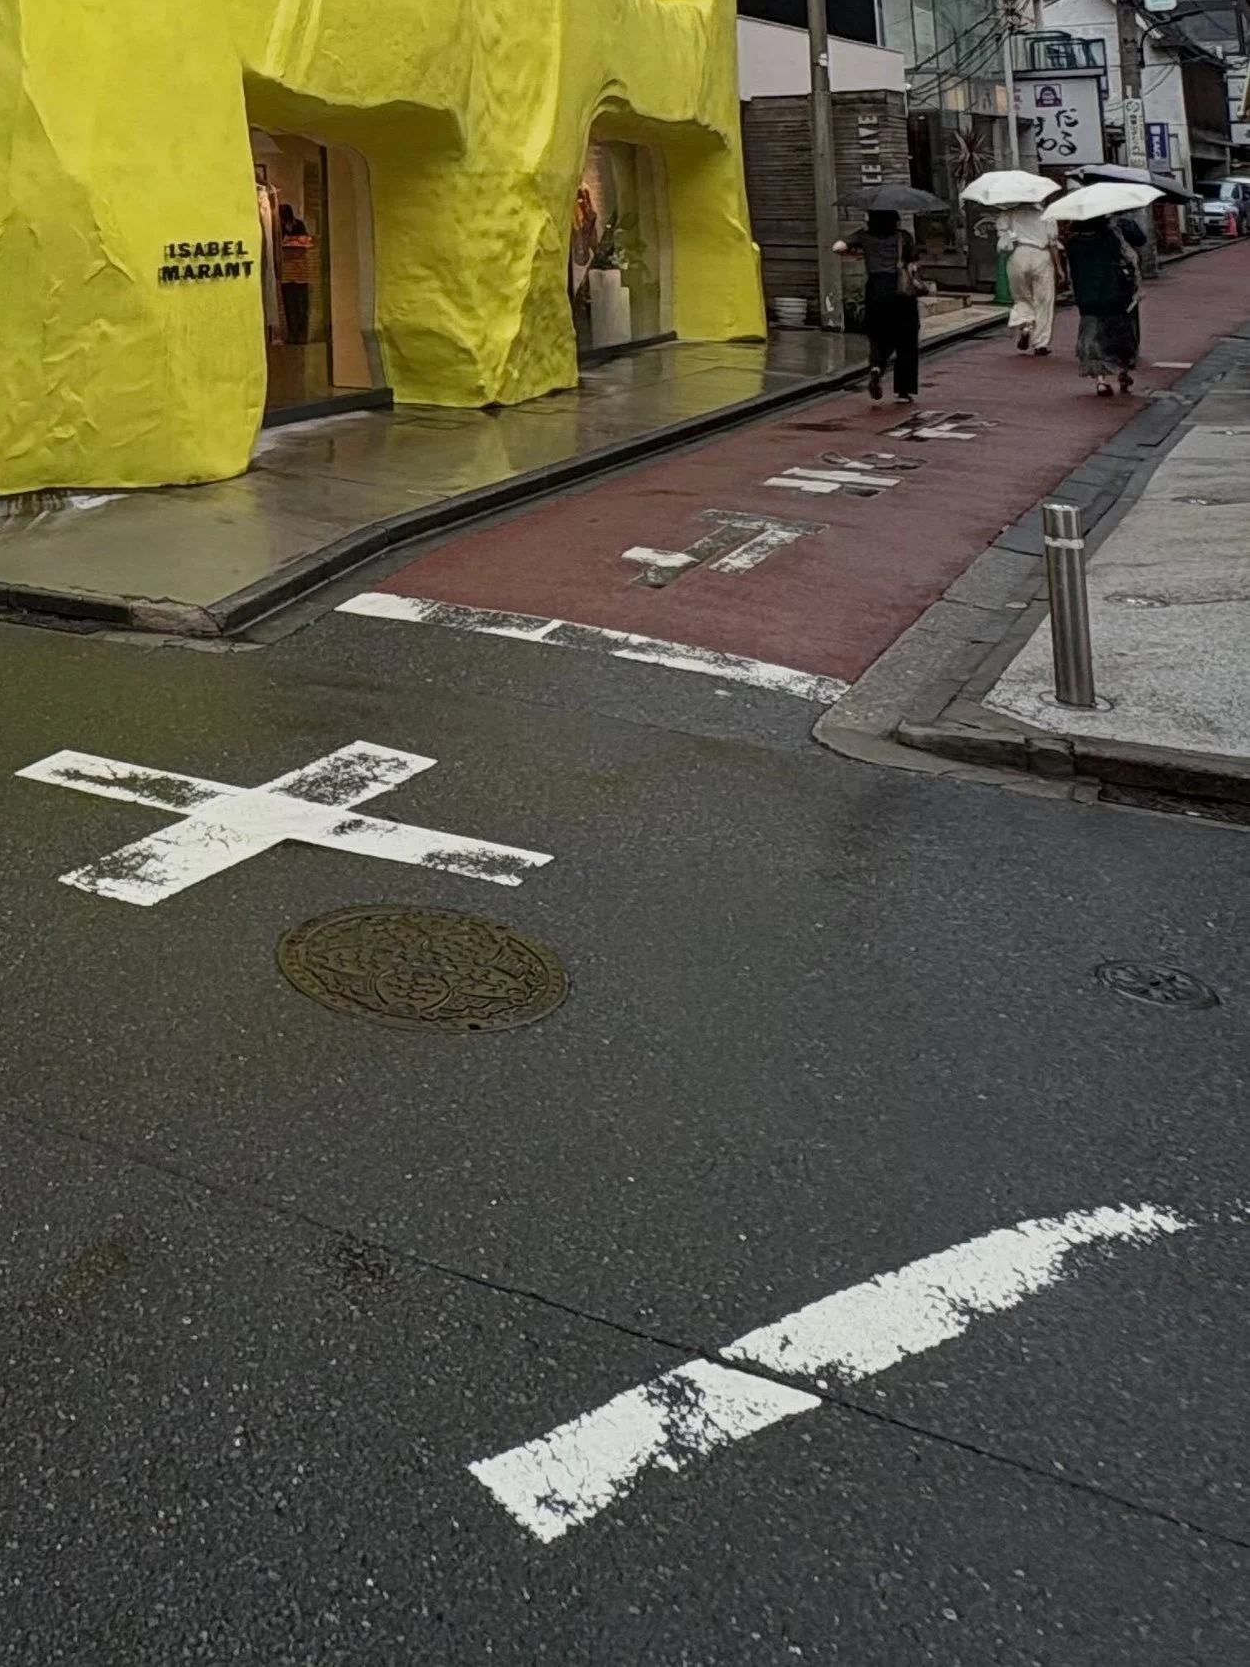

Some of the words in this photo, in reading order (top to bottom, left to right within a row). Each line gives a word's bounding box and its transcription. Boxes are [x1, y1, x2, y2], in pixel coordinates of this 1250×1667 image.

[857, 116, 880, 154] LIVE
[167, 241, 249, 259] ISABEL
[160, 260, 254, 282] MARANT
